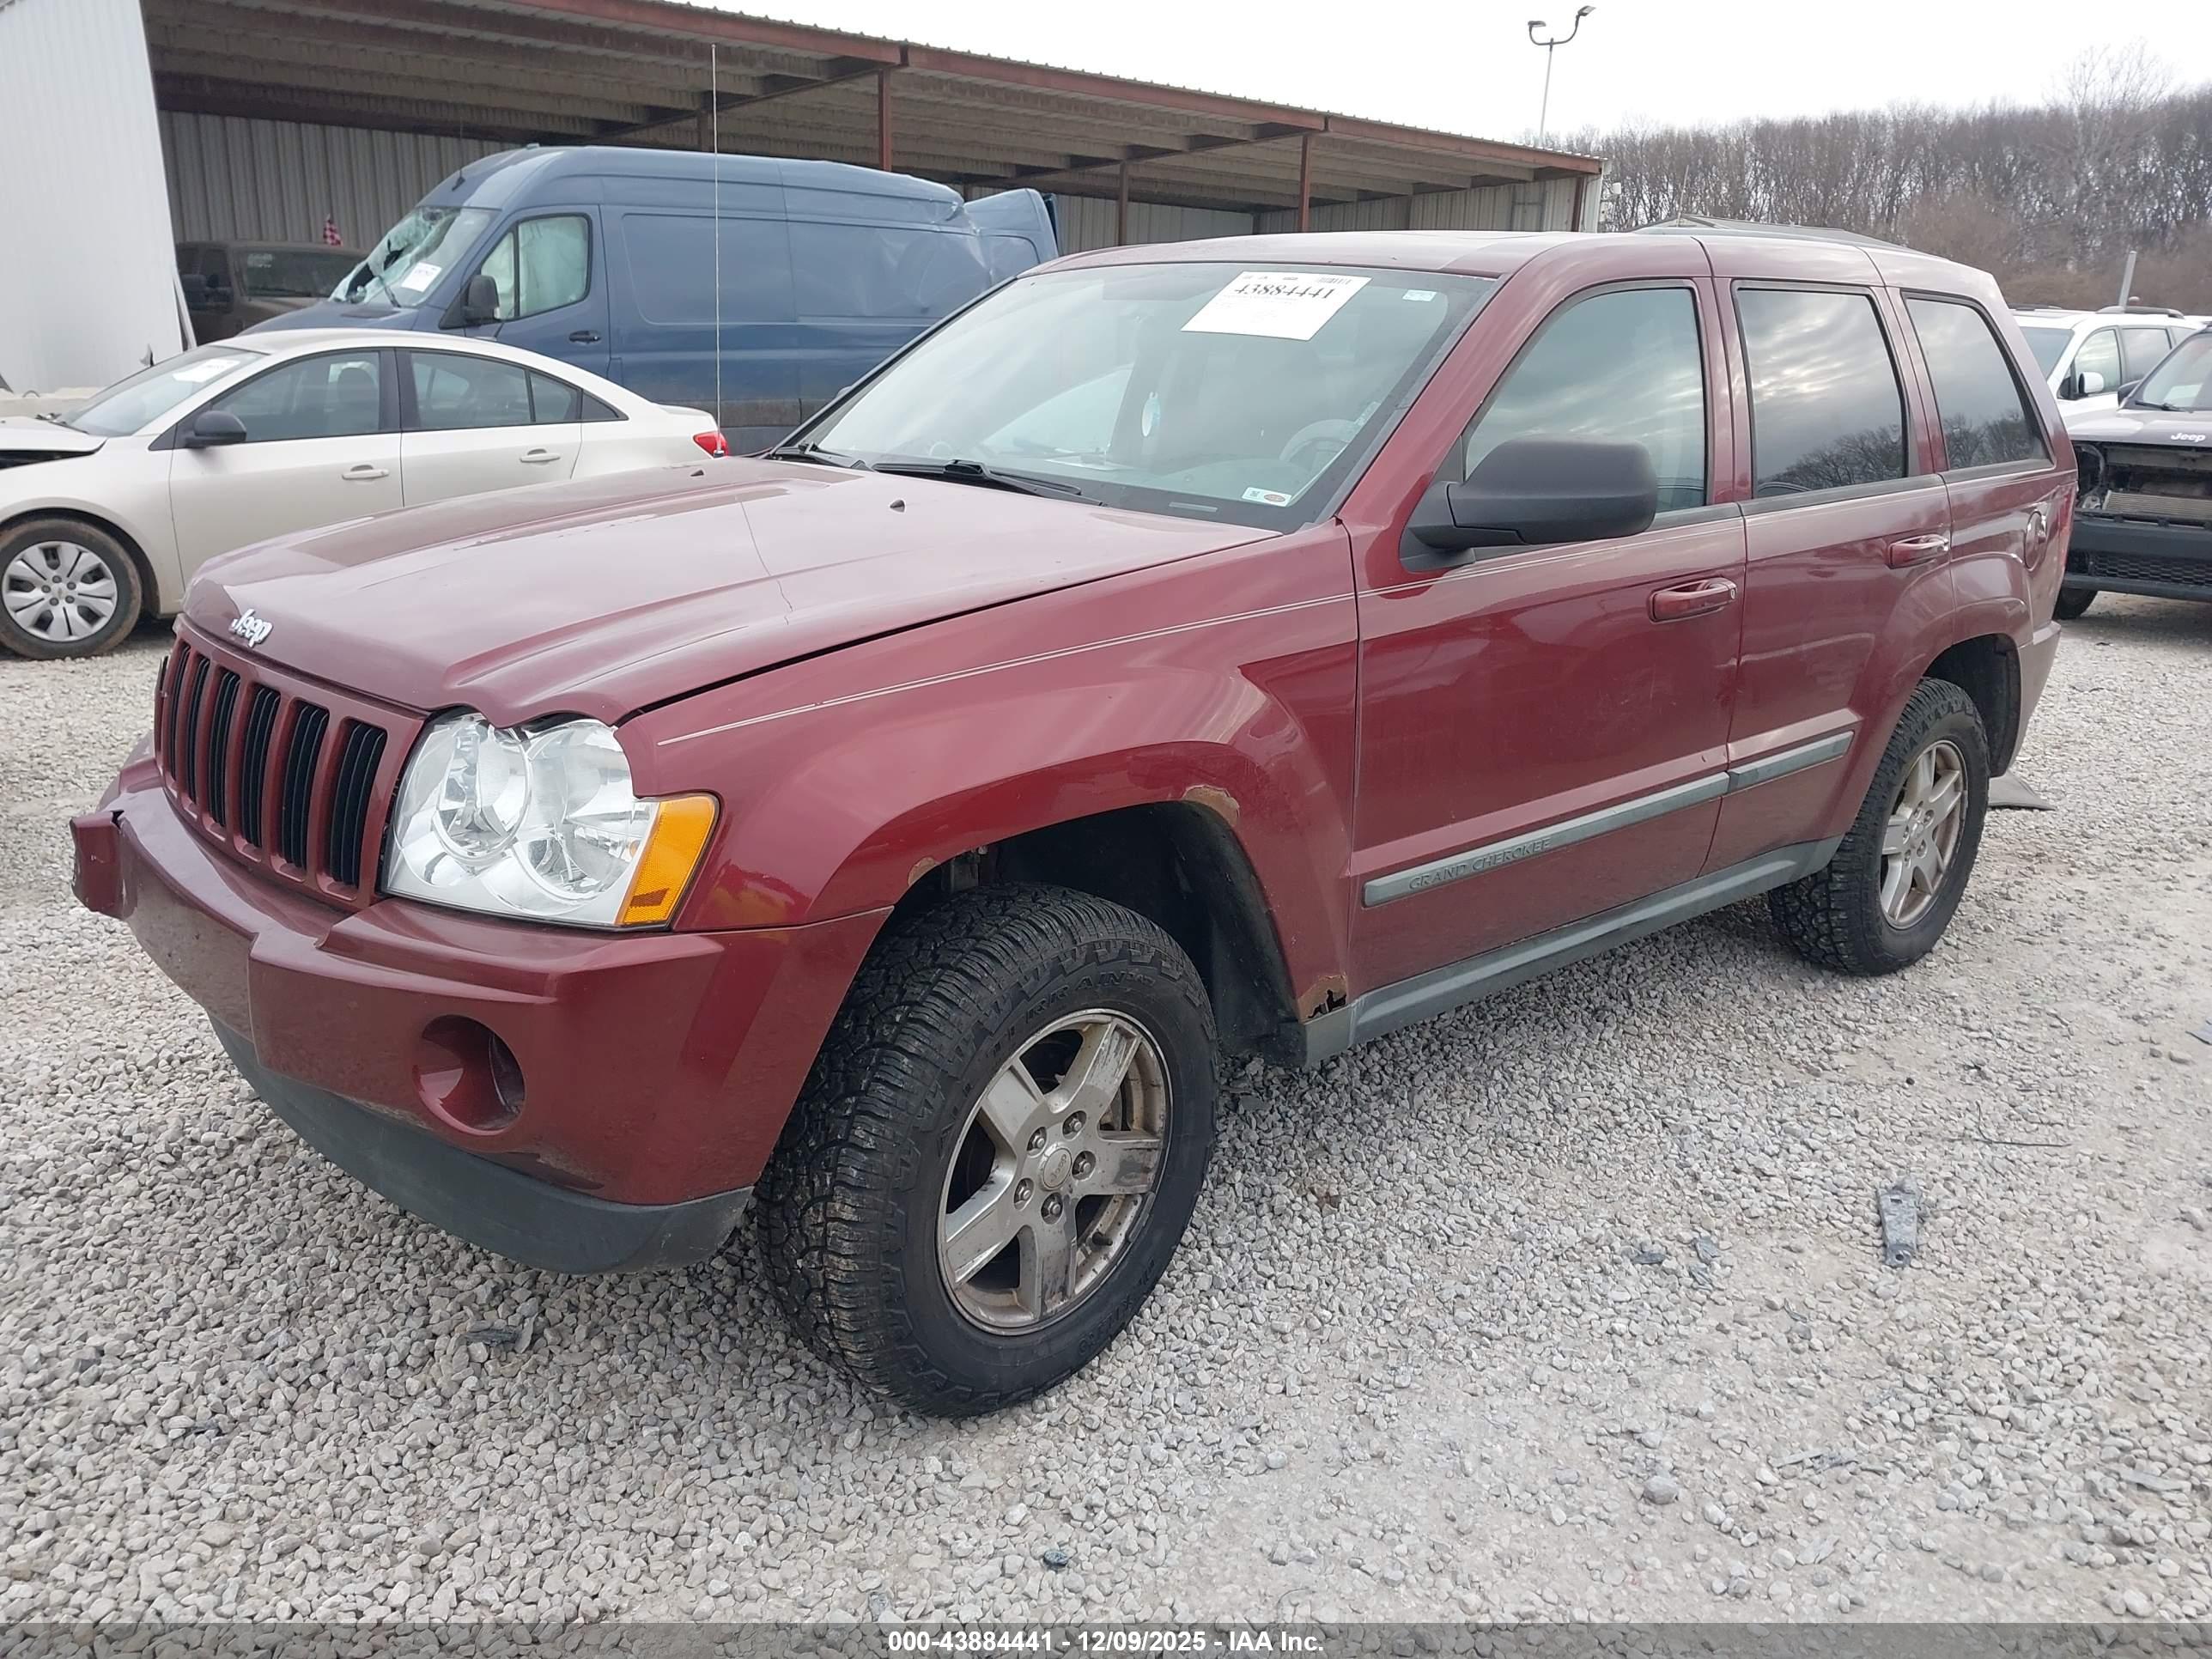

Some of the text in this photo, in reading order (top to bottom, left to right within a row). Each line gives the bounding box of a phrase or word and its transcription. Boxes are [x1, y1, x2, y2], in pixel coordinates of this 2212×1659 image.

[1236, 284, 1335, 299] 43884441
[2170, 432, 2206, 443] Jeep
[230, 608, 273, 648] Jeep
[1409, 839, 1552, 890] GRAND CHEROKEE
